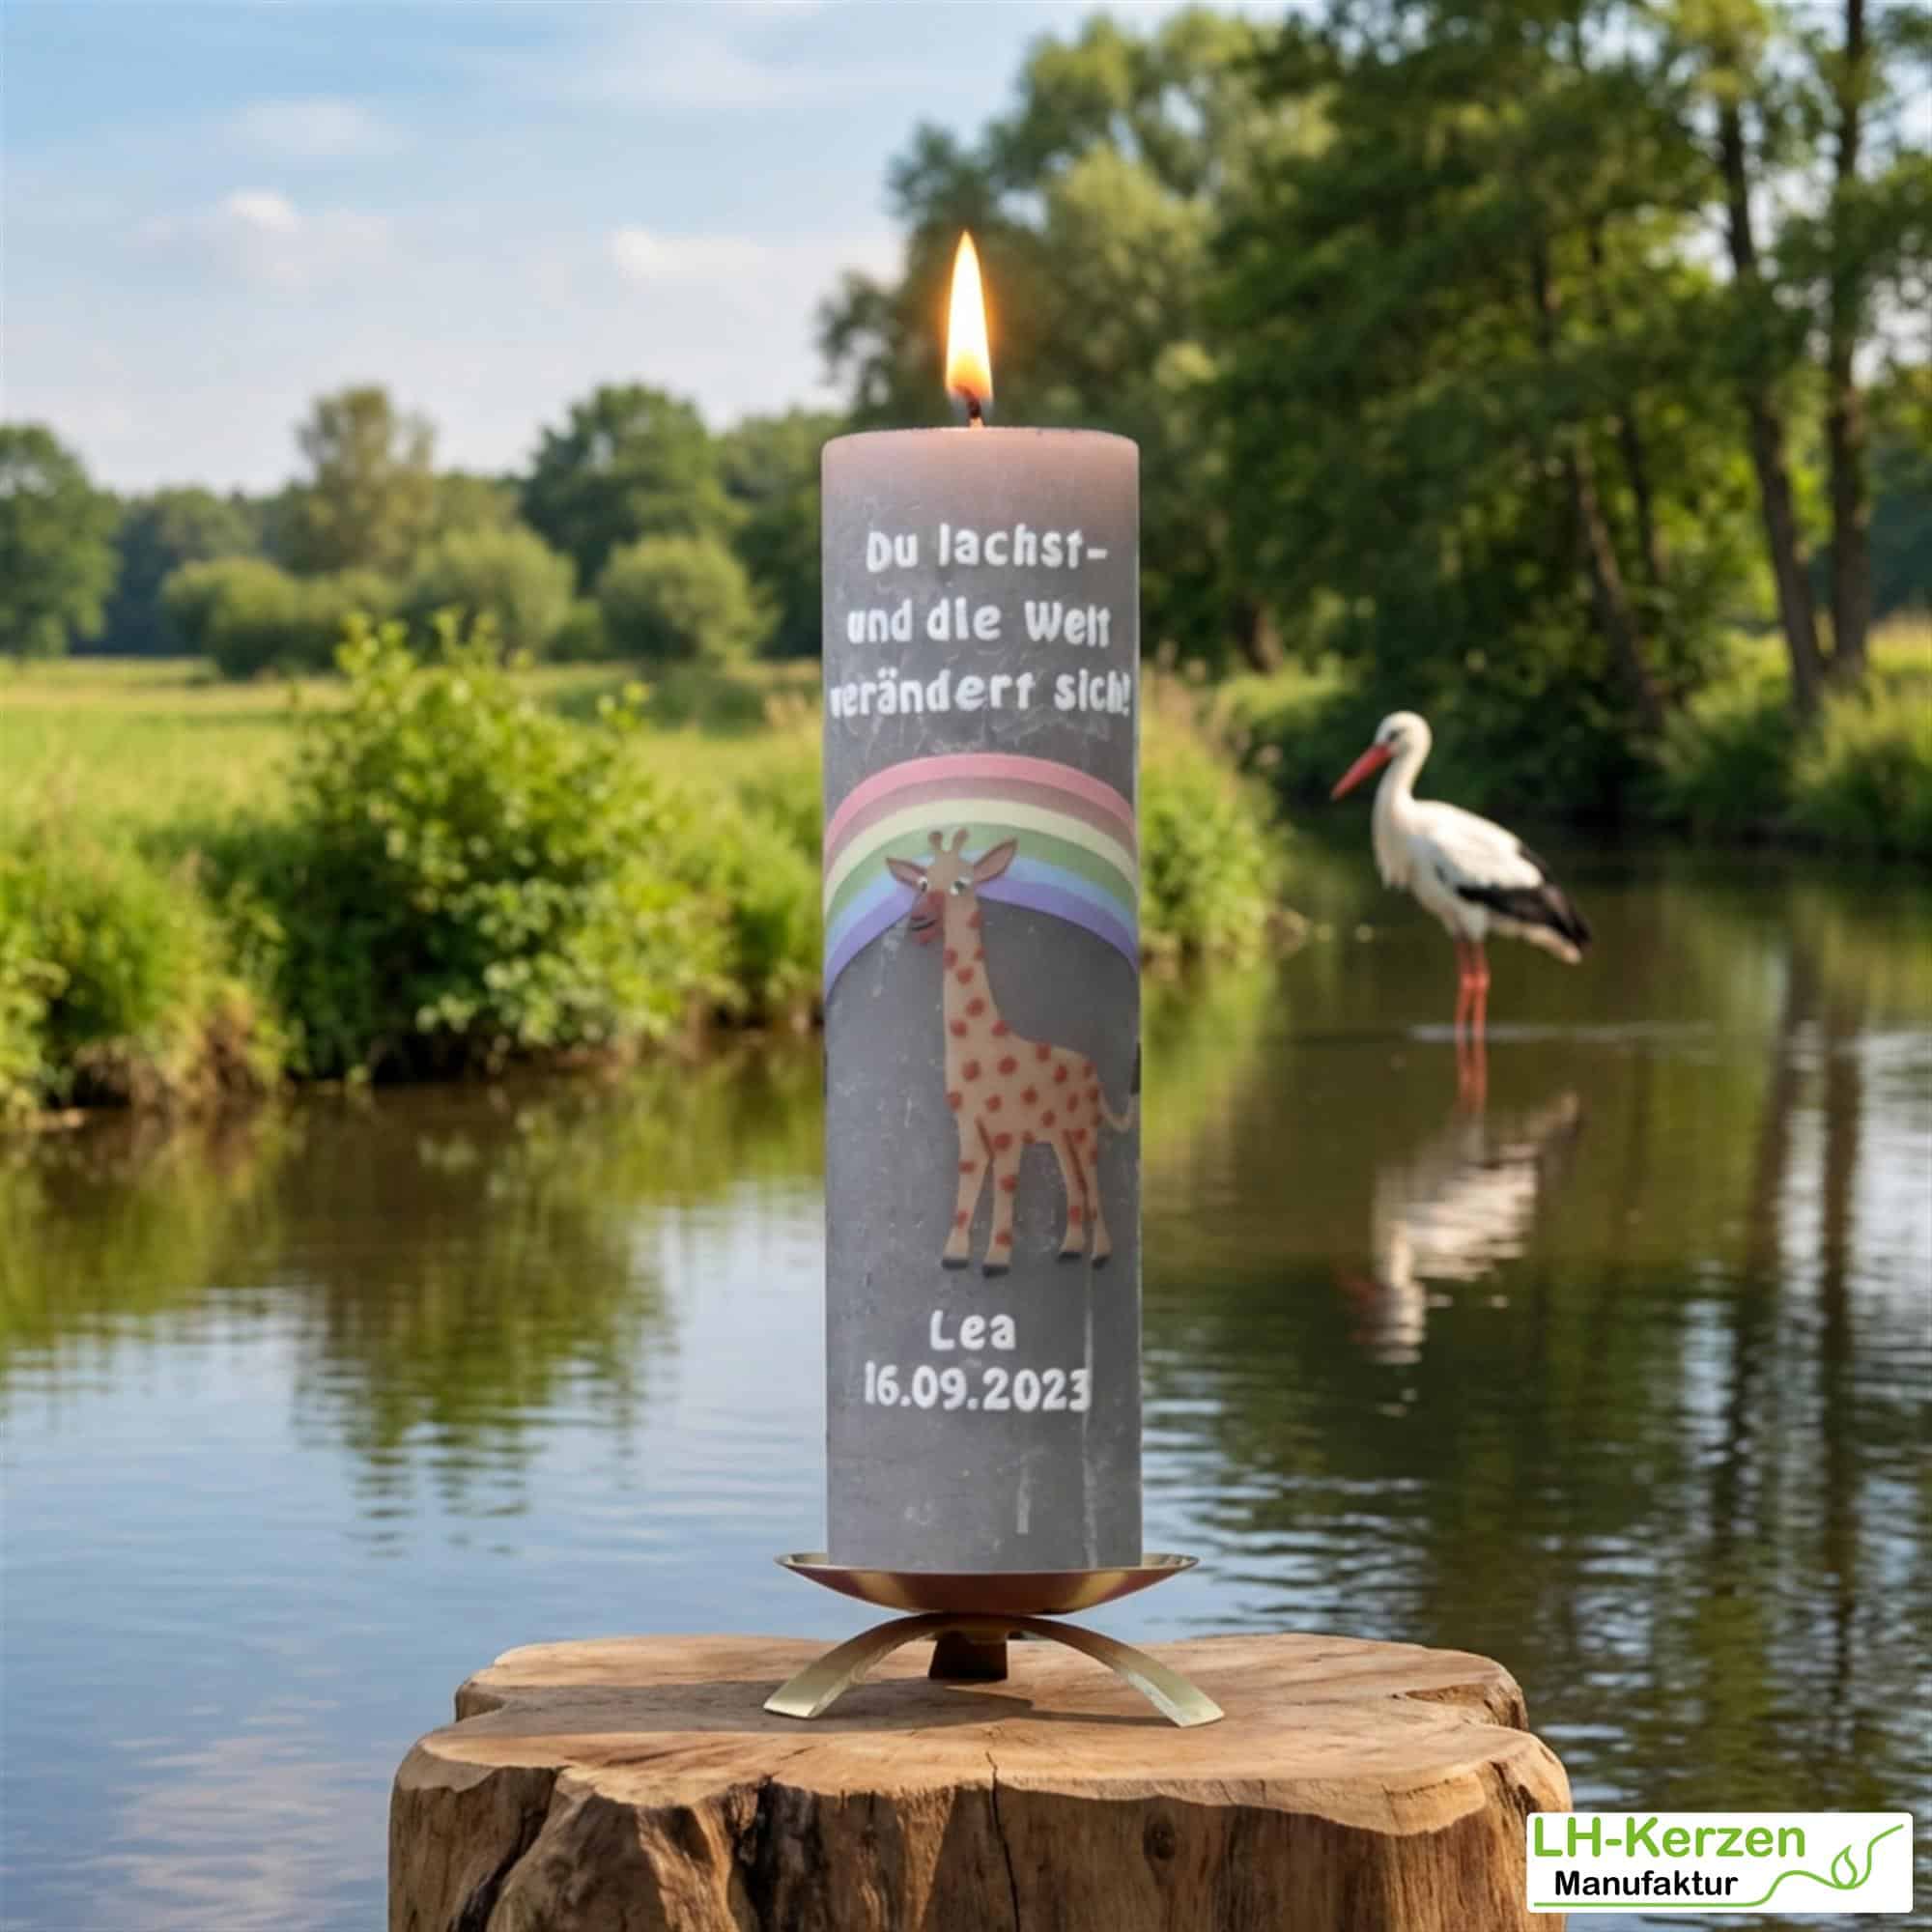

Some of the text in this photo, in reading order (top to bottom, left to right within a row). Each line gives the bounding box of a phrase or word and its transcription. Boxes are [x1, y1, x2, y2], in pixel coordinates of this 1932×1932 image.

[867, 523, 1108, 572] Du lachst-
[846, 596, 1111, 647] und die Welt
[1054, 668, 1131, 716] sich!
[929, 1309, 1016, 1350] Lea
[865, 1360, 1093, 1411] 16.09.2023
